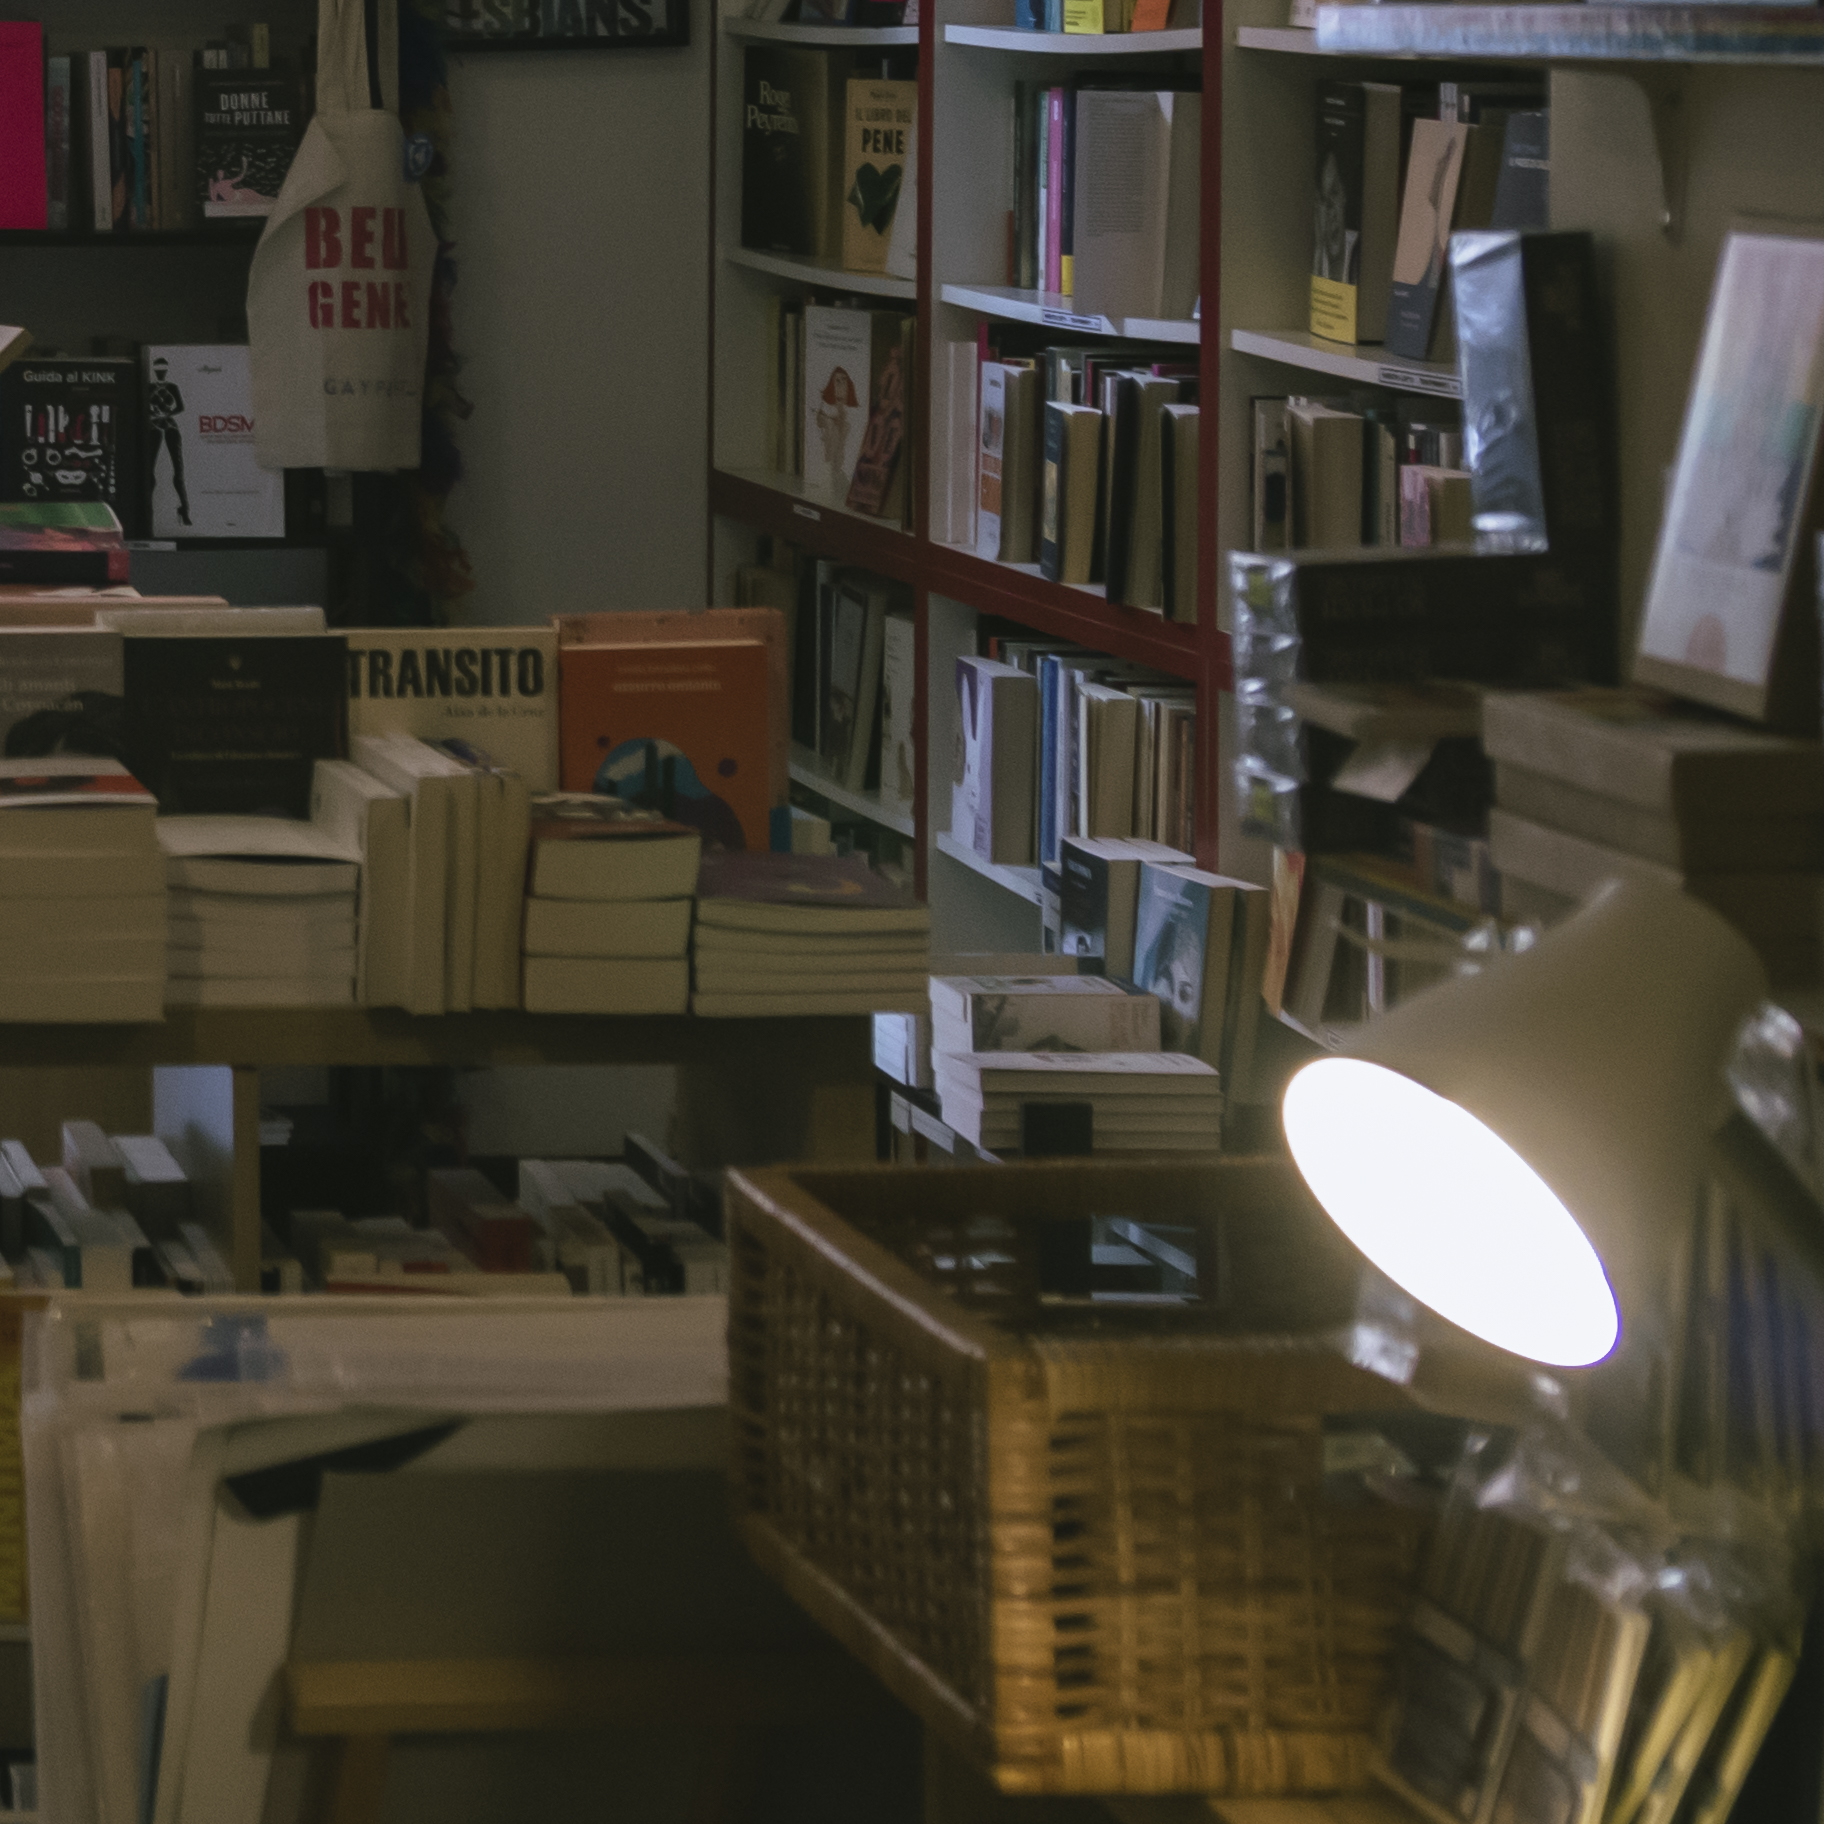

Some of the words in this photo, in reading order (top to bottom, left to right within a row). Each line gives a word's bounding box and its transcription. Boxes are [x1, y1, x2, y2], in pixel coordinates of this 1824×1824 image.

[219, 91, 270, 111] DONNE
[234, 109, 291, 126] PUTTANE
[861, 128, 905, 155] PENE
[23, 370, 63, 384] Guida
[66, 370, 79, 383] al
[81, 370, 117, 384] KINK
[348, 647, 544, 698] TRANSITO
